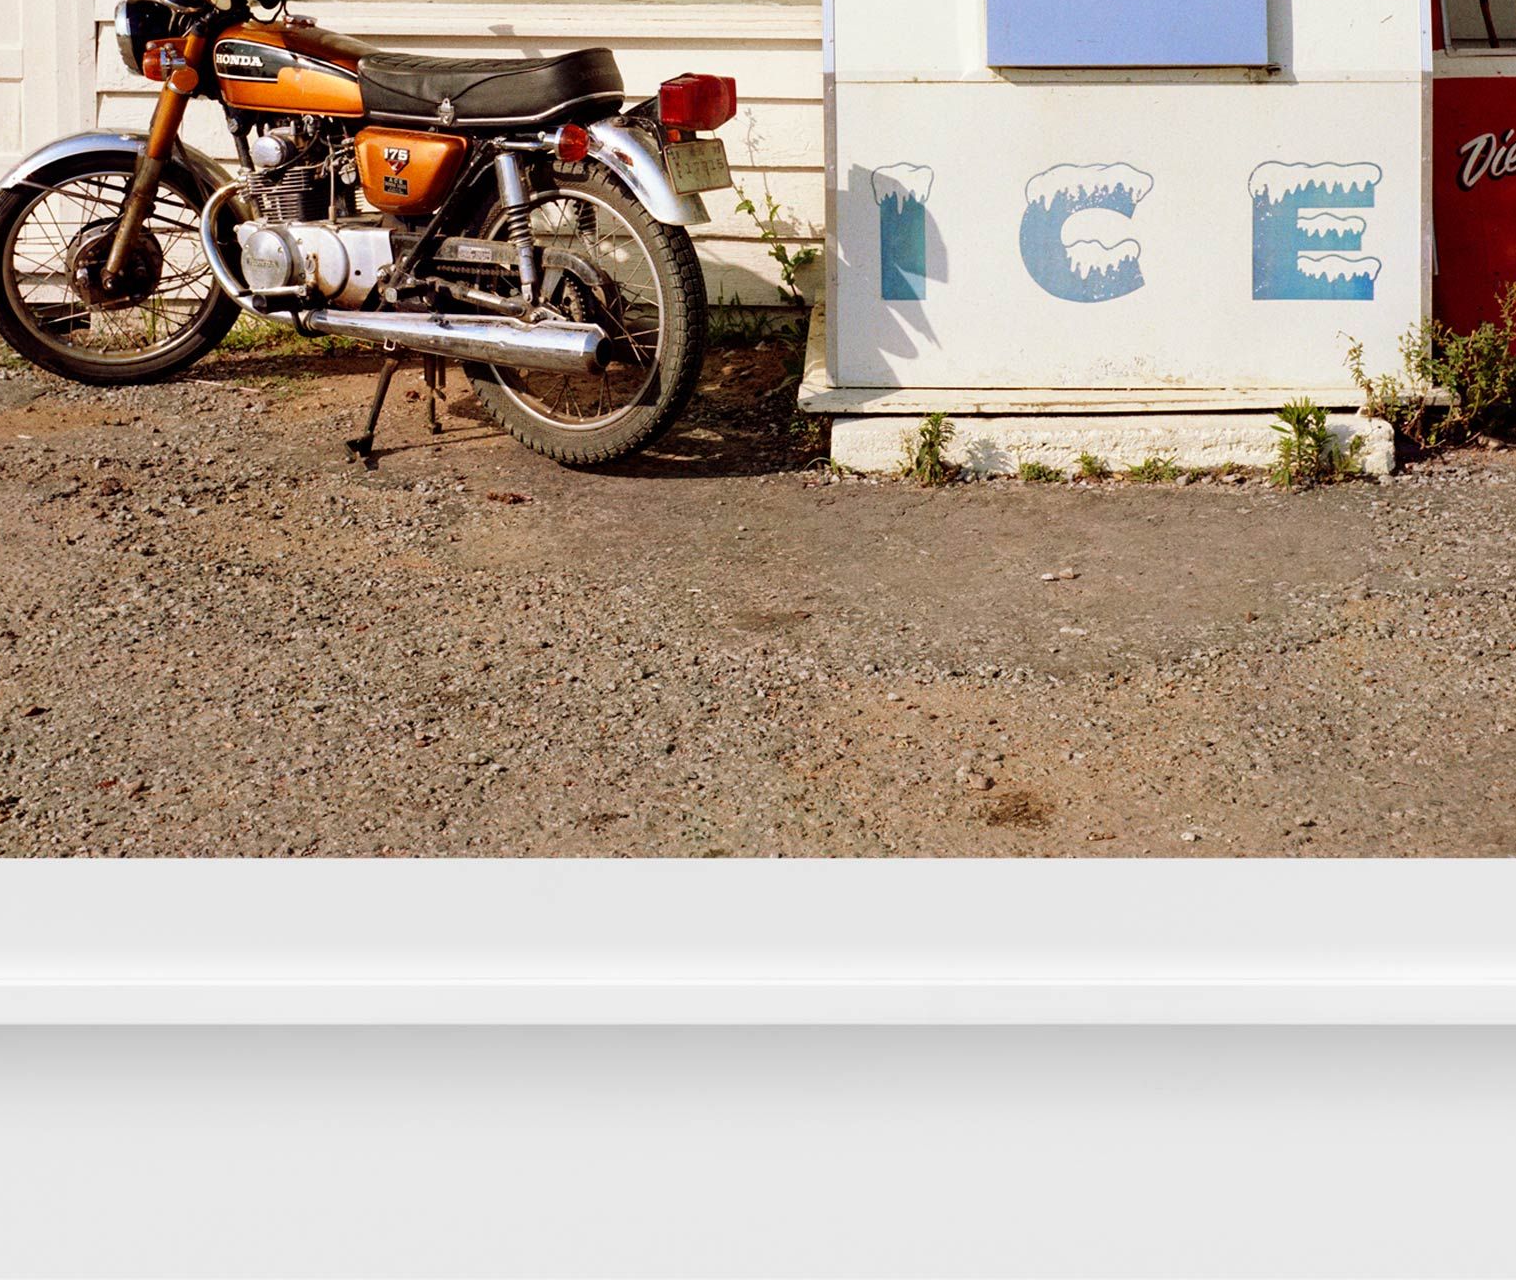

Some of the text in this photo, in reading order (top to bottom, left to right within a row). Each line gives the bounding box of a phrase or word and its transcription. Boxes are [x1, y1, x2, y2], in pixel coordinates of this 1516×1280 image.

[216, 54, 263, 67] HONDA
[384, 148, 409, 161] 175
[871, 160, 1383, 303] ICE
